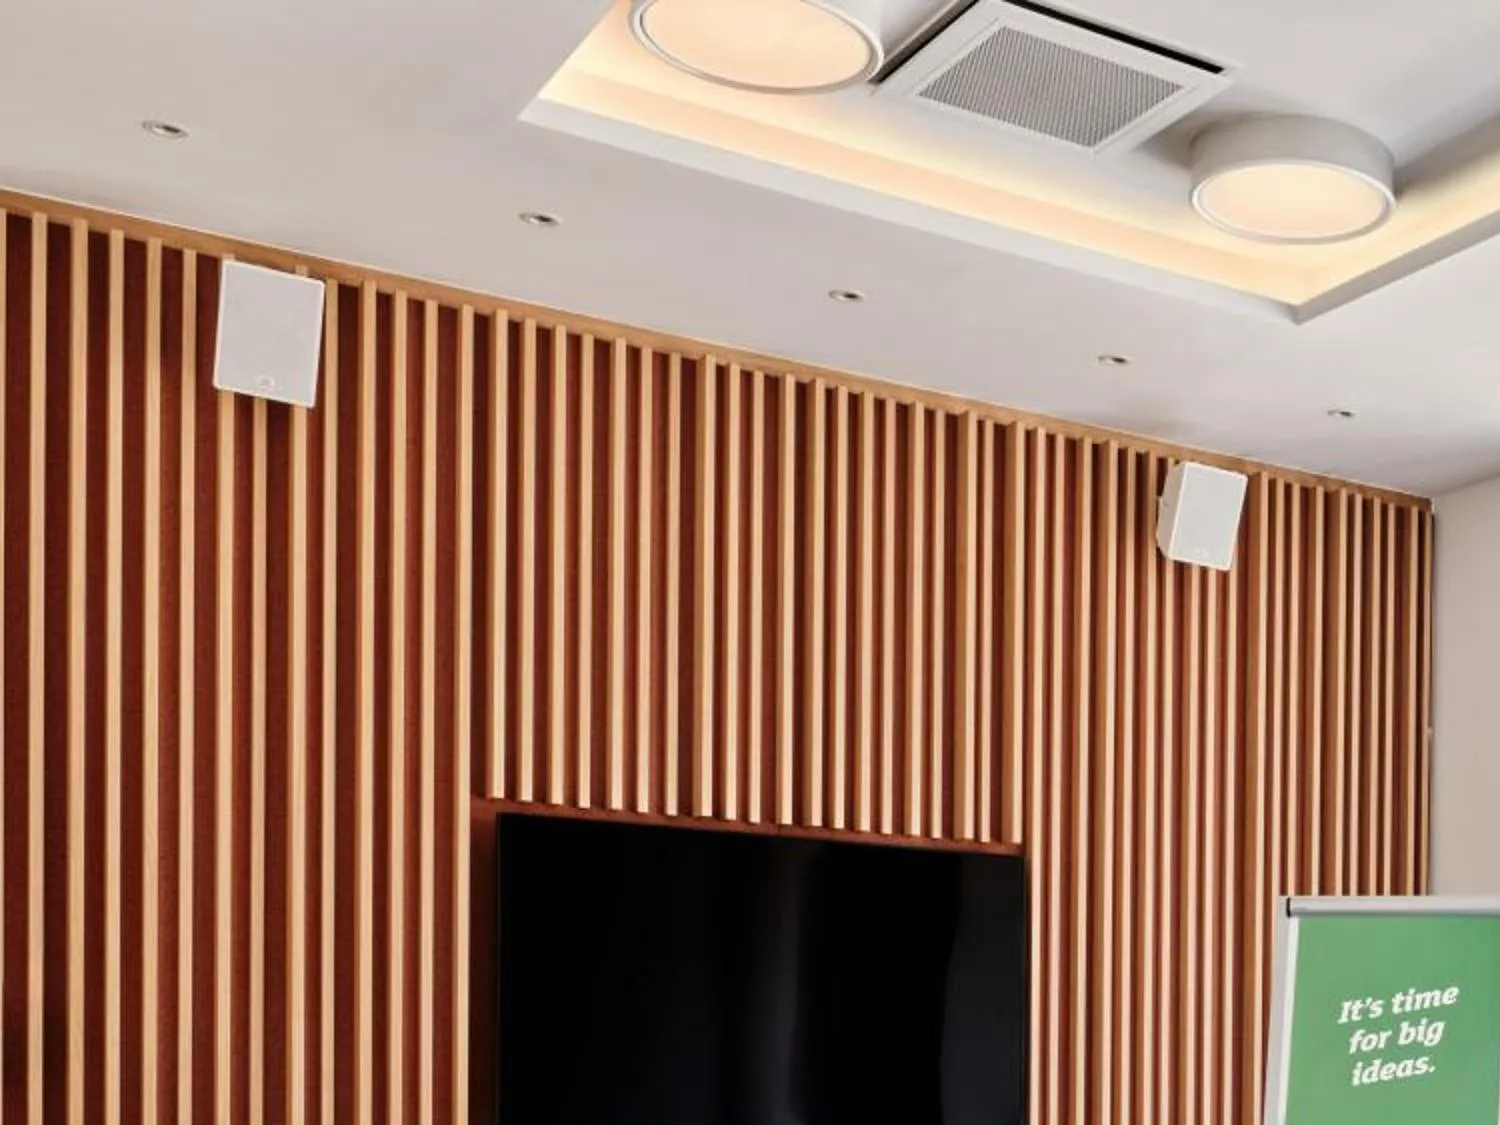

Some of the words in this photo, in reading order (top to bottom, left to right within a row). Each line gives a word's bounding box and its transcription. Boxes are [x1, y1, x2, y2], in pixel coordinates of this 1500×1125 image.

[1336, 997, 1385, 1025] It's
[1391, 986, 1460, 1015] time
[1348, 1028, 1393, 1055] for
[1397, 1017, 1447, 1047] big
[1351, 1056, 1436, 1087] ideas.
